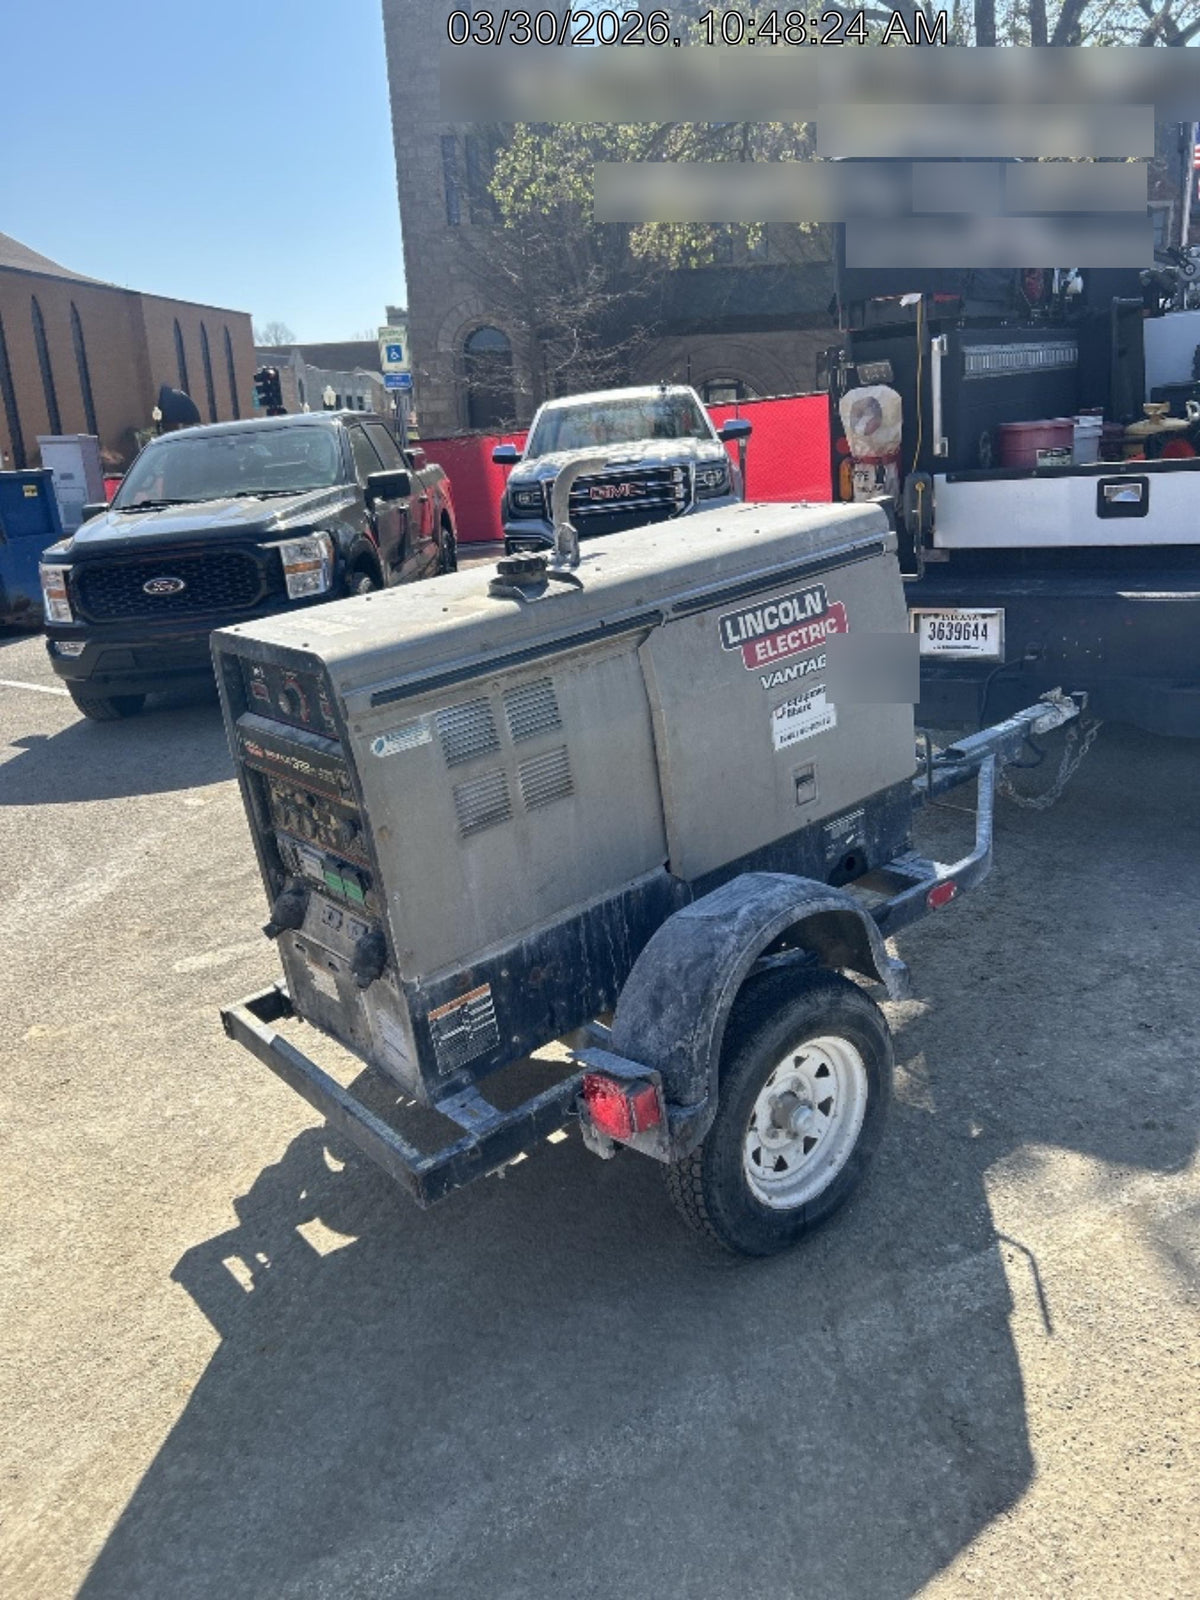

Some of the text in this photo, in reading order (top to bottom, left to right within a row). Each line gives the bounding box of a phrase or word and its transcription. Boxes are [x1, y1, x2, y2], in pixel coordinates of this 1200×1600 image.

[725, 591, 823, 644] LINCOLN
[928, 621, 988, 641] 3639644
[755, 618, 838, 661] ELECTRIC
[759, 653, 826, 690] VANTAG
